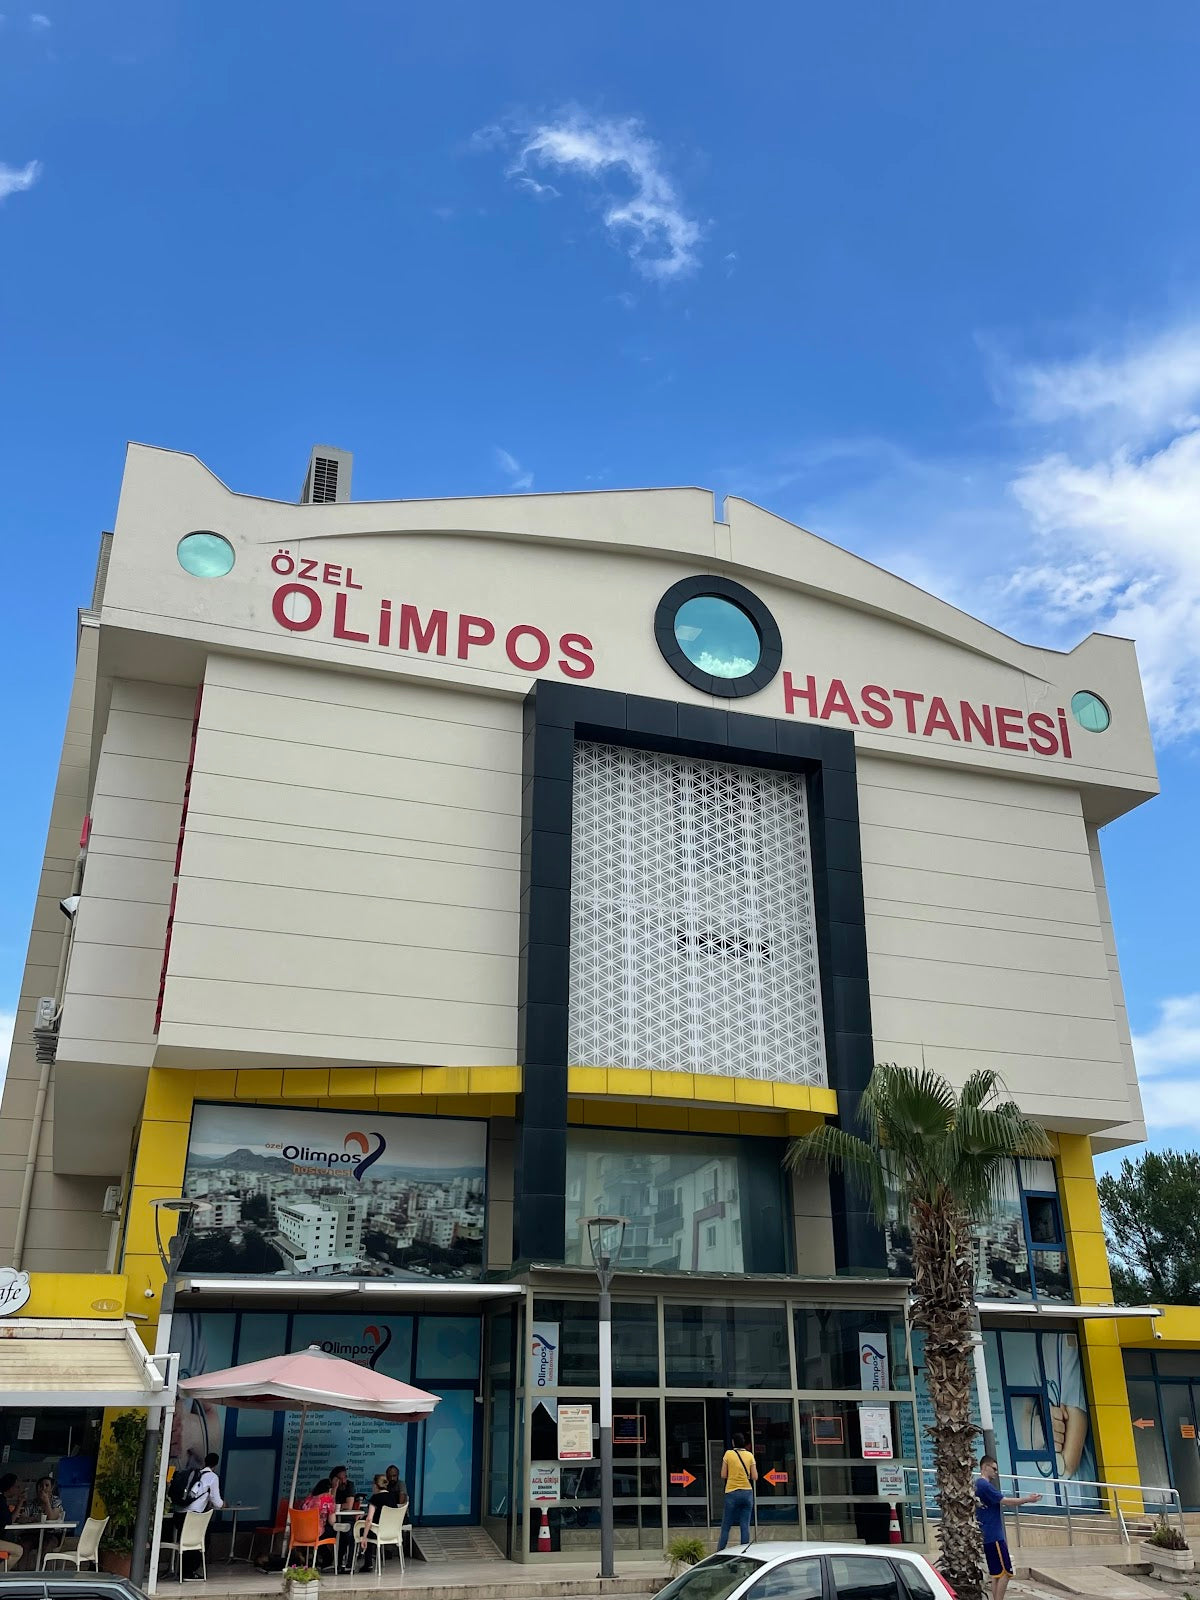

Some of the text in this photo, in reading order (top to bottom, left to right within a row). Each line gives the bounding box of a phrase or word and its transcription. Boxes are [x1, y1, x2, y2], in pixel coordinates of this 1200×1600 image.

[271, 549, 362, 590] ÖZEL
[783, 671, 1072, 758] HASTANESİ
[282, 1145, 362, 1168] Olimpos
[322, 1341, 375, 1358] Olimpos
[537, 1346, 549, 1387] Olimpos
